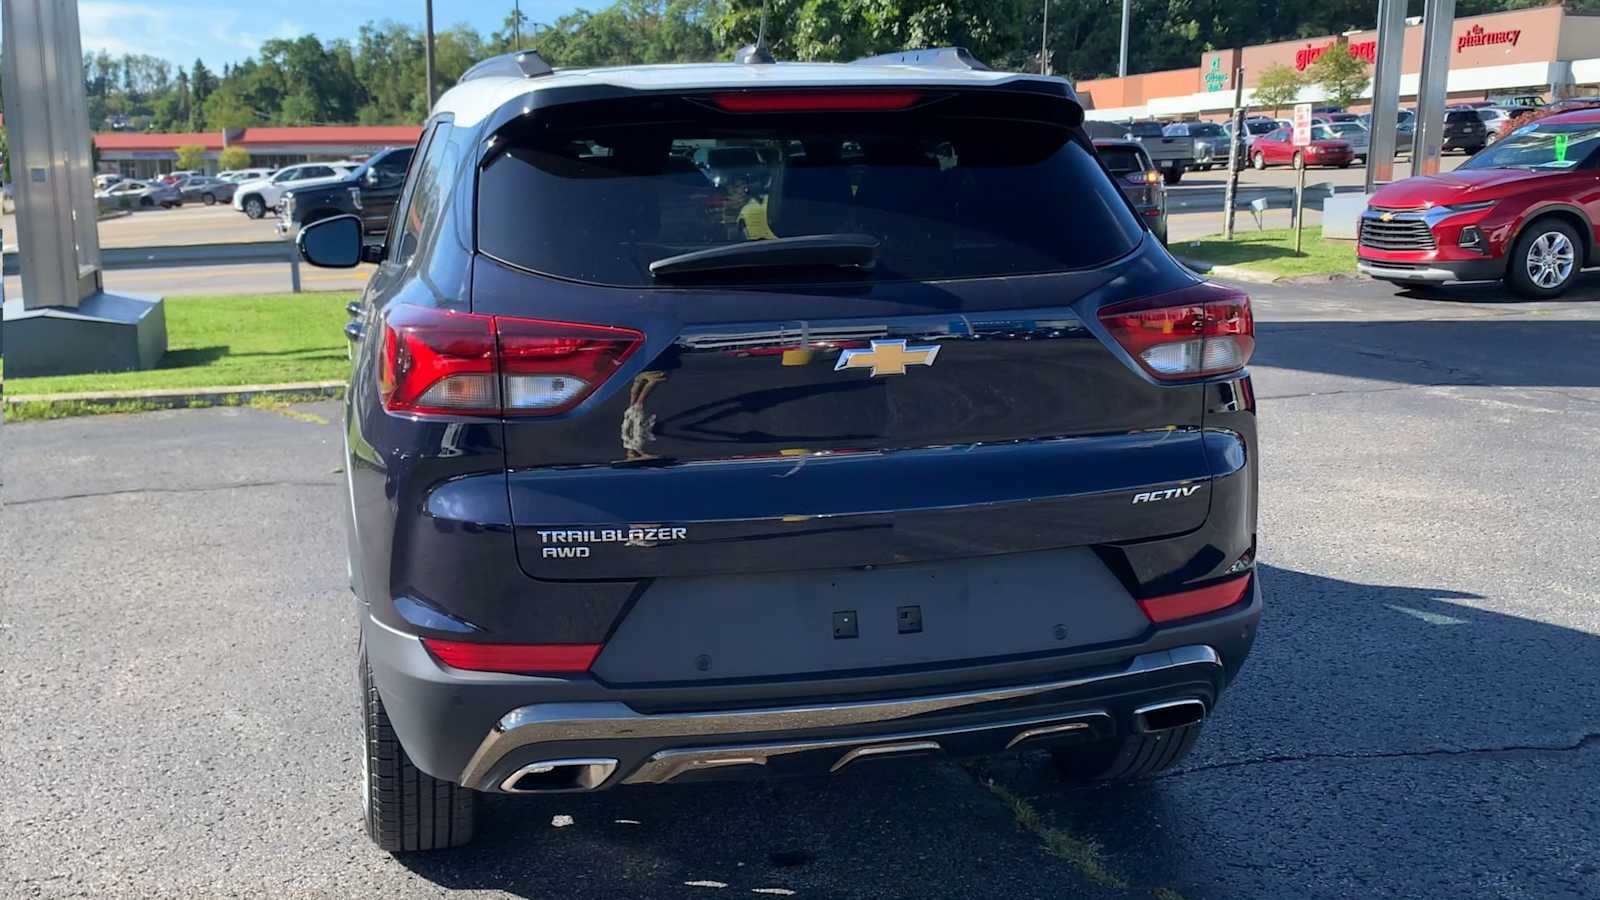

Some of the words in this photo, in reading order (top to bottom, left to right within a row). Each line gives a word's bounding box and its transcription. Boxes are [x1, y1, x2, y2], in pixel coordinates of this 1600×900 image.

[1457, 30, 1521, 53] pharmacy
[1132, 485, 1201, 504] ACTIV
[537, 527, 687, 543] TRAILBLAZER
[542, 547, 590, 558] AWD
